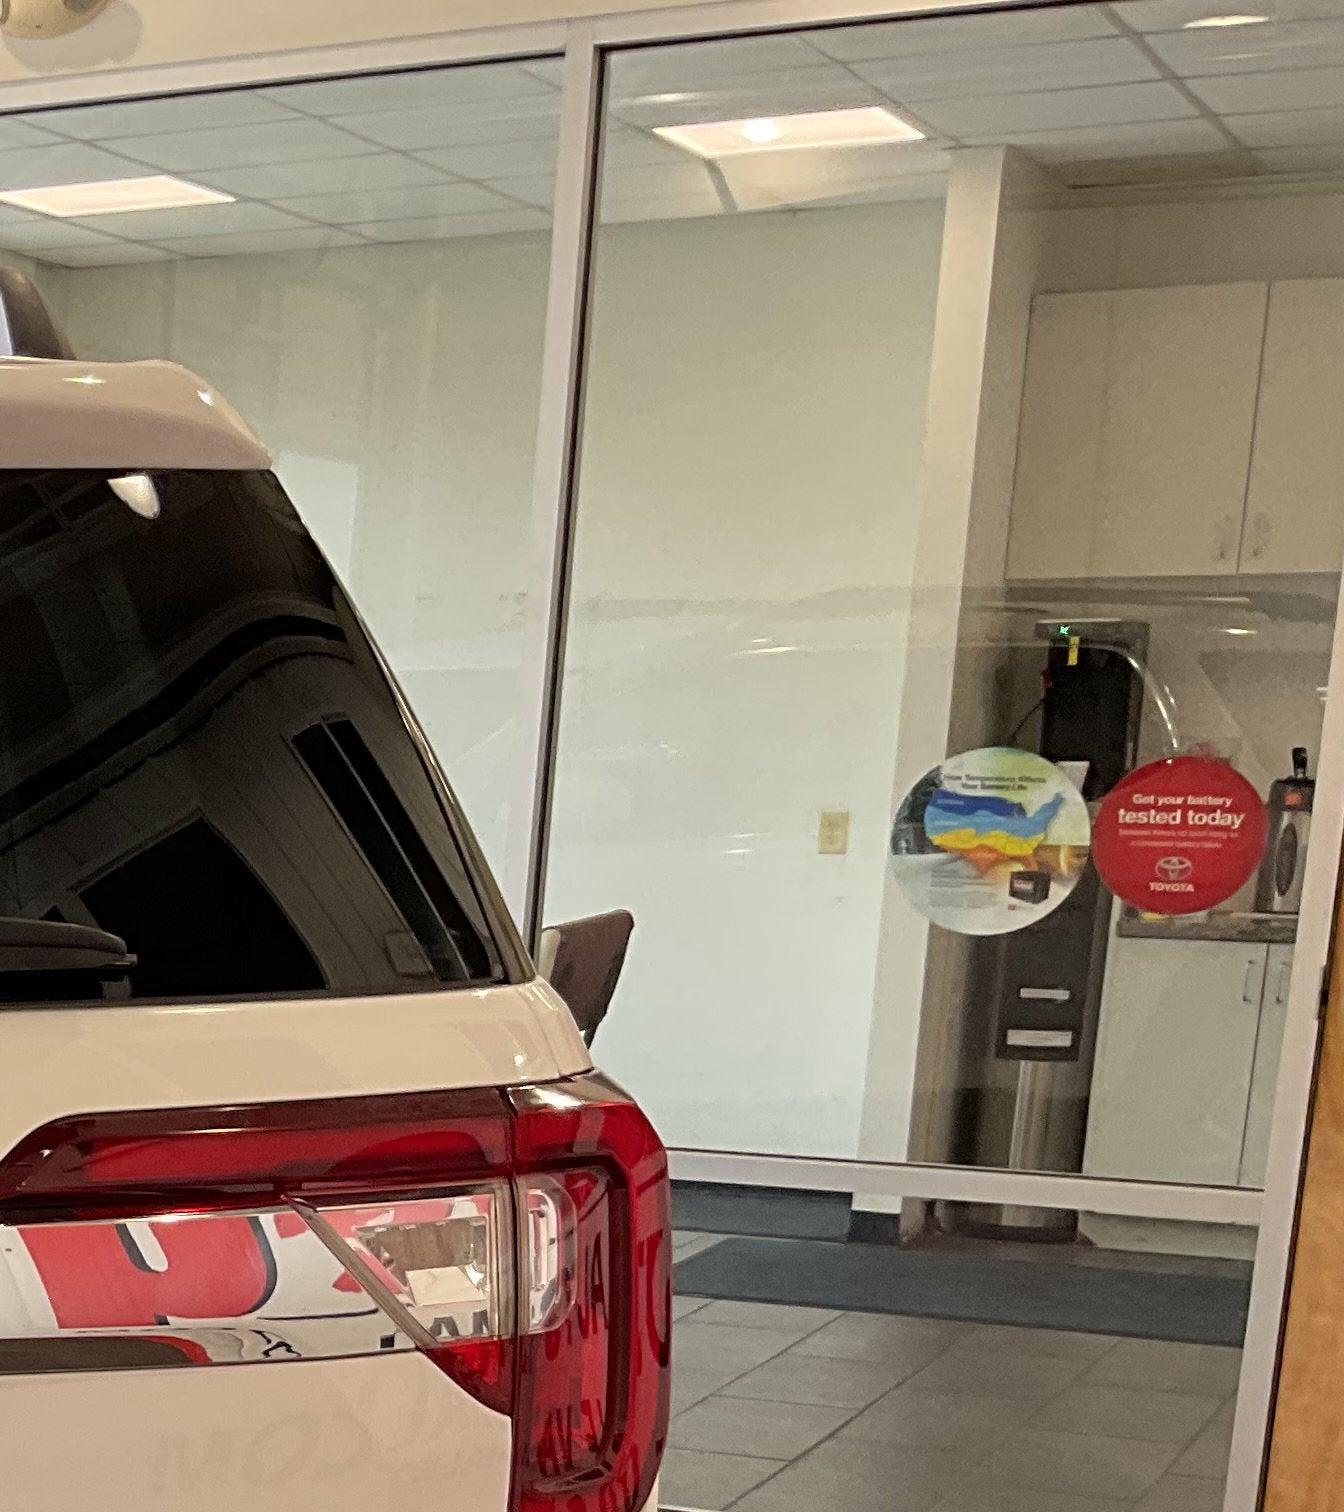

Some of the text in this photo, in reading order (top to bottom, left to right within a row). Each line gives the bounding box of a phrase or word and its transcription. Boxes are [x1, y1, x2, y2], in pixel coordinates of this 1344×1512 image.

[1132, 794, 1233, 808] Get your battery
[1118, 808, 1246, 829] tested today
[1149, 882, 1194, 892] TOYOTA
